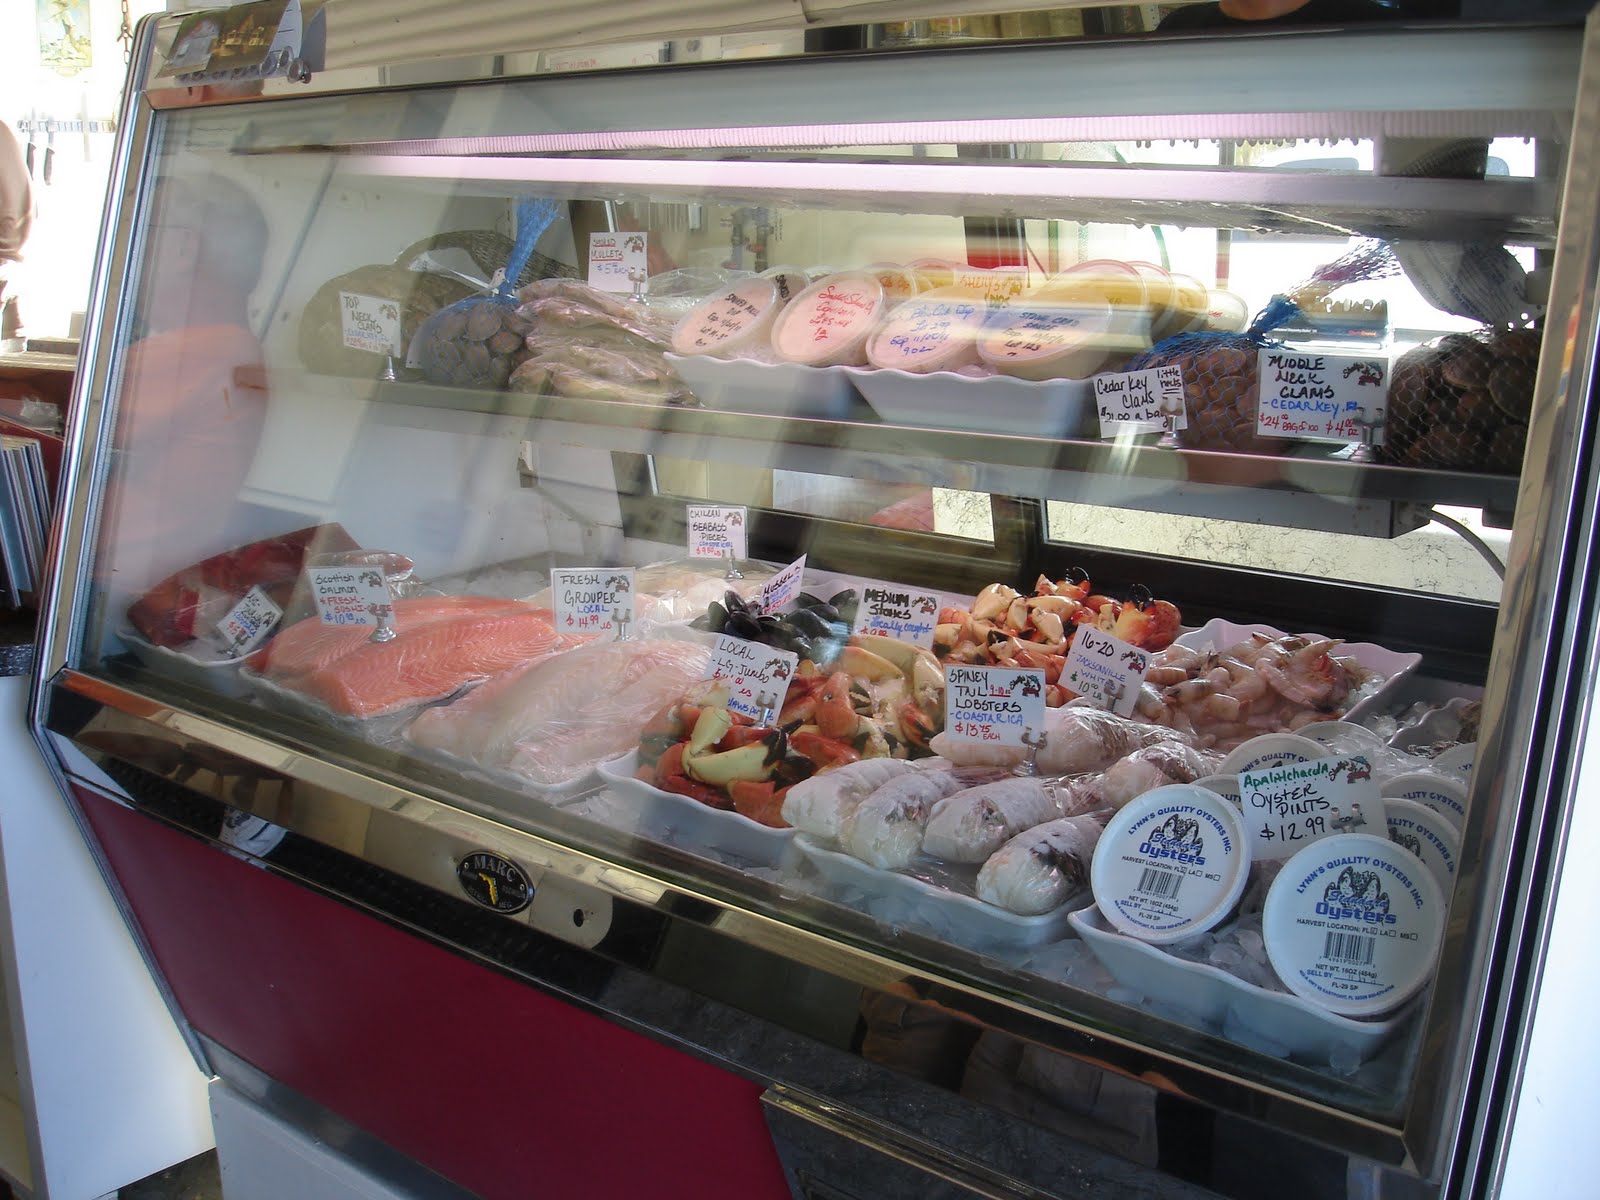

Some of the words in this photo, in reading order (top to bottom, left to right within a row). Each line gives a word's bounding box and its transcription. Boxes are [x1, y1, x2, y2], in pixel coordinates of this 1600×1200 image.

[343, 296, 359, 309] TOP
[351, 310, 377, 323] NECK
[1268, 355, 1325, 371] MIDDLE
[1275, 370, 1325, 385] NECK
[1097, 378, 1125, 395] Cedar
[1128, 375, 1148, 398] Key
[1280, 385, 1335, 399] CLAMS
[560, 575, 600, 585] FRESH
[564, 590, 621, 607] GROUPER
[864, 588, 910, 607] MEDIUM
[577, 605, 610, 613] LOCAL
[719, 639, 755, 660] LOCAL
[1081, 631, 1114, 657] 16-20
[1076, 654, 1126, 682] JACKSONVILLE
[949, 669, 988, 690] SPINEY
[955, 698, 1022, 713] LOBSTERS
[982, 732, 1000, 741] EACH
[1261, 753, 1297, 762] QUALITY
[1275, 797, 1330, 818] PINTS
[1128, 812, 1156, 835] LYNN'S
[1157, 806, 1196, 816] QUALITY
[1196, 809, 1226, 836] OYSTERS
[1222, 836, 1232, 855] INC.
[1260, 816, 1325, 841] $12.99
[1416, 825, 1451, 860] OYSTERS
[1139, 842, 1206, 865] Oysters
[474, 855, 516, 882] MARC
[1121, 855, 1146, 865] HARVEST
[1145, 860, 1173, 870] LOCATION:
[1297, 867, 1326, 894] LYNN'S
[1327, 856, 1371, 870] QUALITY
[1372, 859, 1413, 889] OYSTERS
[1410, 888, 1424, 909] INC.
[1328, 889, 1389, 908] Standard
[1315, 902, 1397, 924] Oysters
[1297, 918, 1326, 928] HARVEST
[1326, 922, 1360, 933] LOCATION:
[1307, 969, 1322, 977] SELL
[1358, 969, 1378, 979] (454g)
[1331, 981, 1348, 990] FL-29
